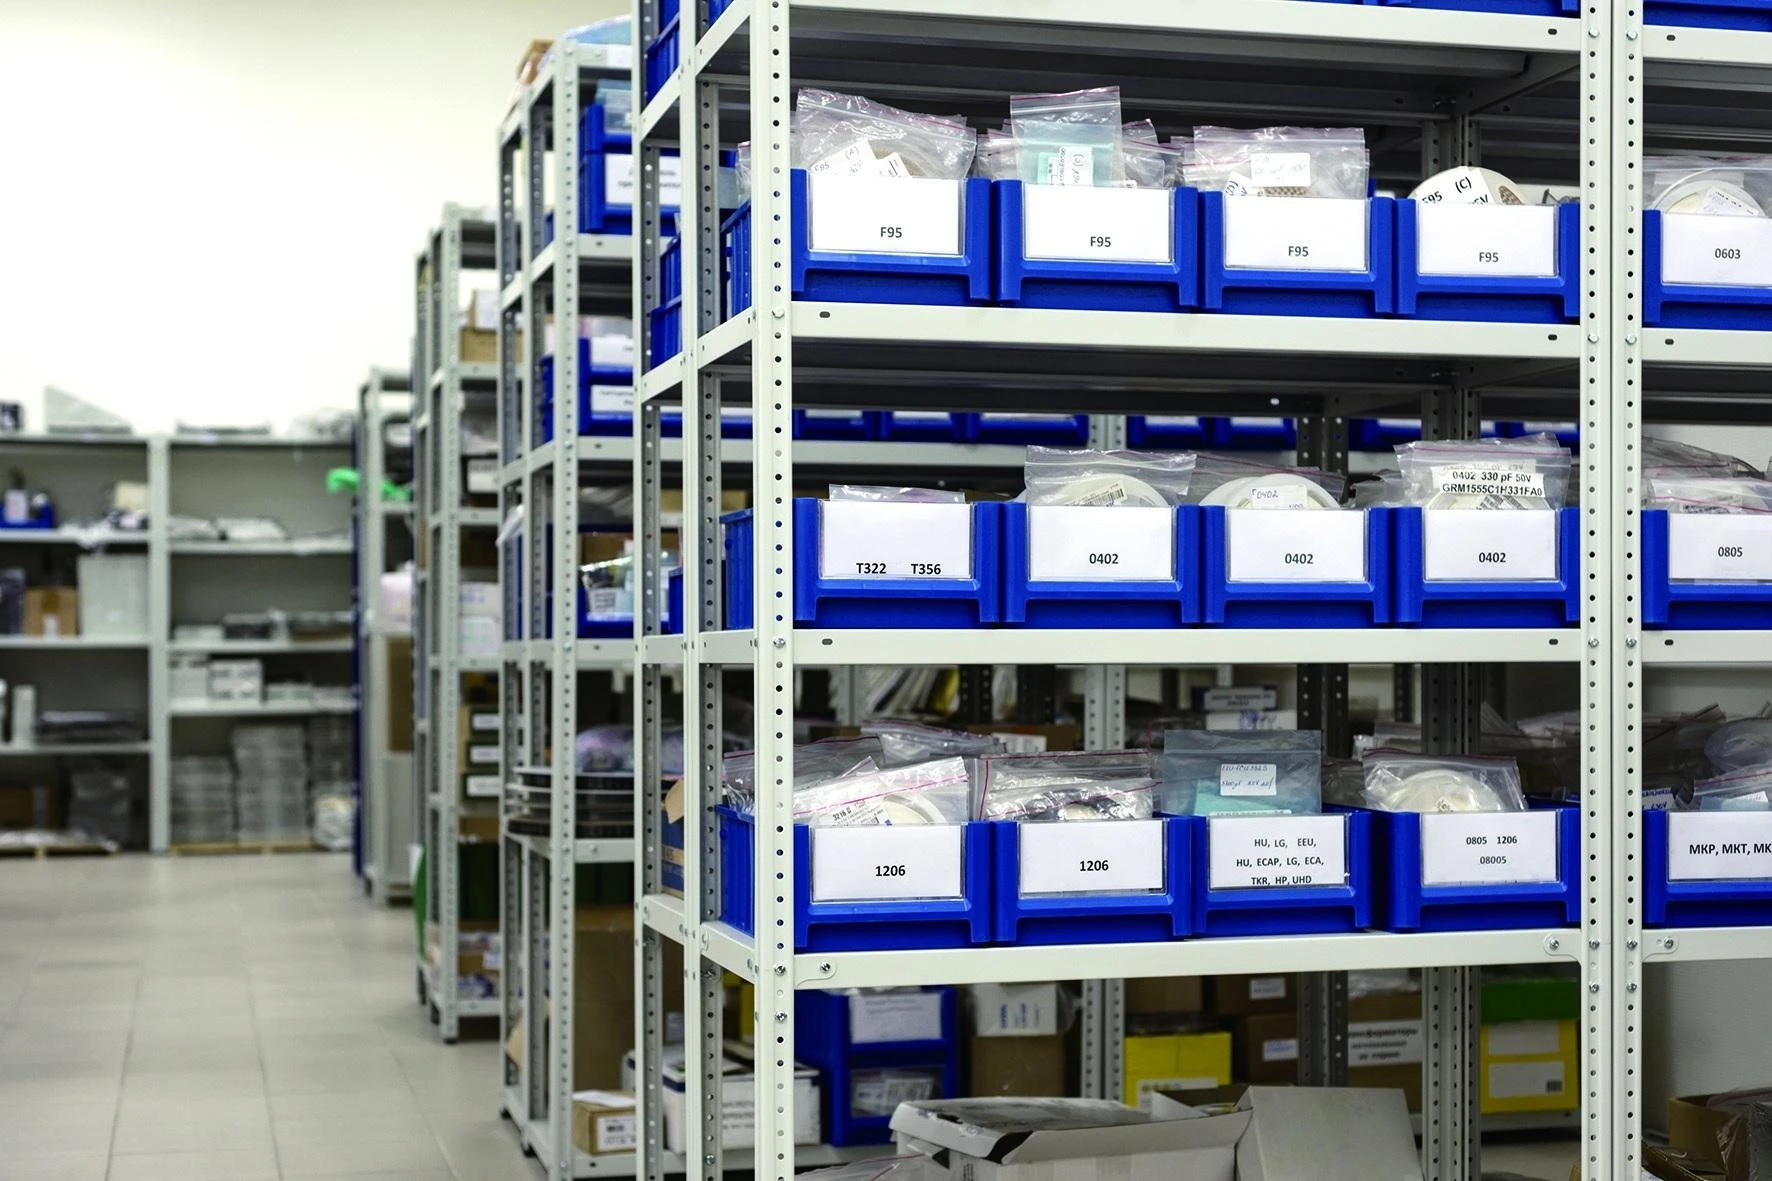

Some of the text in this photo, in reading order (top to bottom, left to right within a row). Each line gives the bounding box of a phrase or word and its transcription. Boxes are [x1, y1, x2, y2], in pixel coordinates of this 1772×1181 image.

[1454, 176, 1472, 194] (C)
[880, 226, 903, 239] F95
[1089, 236, 1112, 248] F95
[1288, 245, 1309, 258] F95
[1478, 251, 1499, 263] F95
[1714, 247, 1741, 260] 0603
[1452, 470, 1532, 483] 0402 330 pF 50V
[1088, 552, 1119, 565] 0402
[1284, 552, 1314, 565] 0402
[1478, 551, 1507, 564] 0402
[1717, 546, 1743, 558] 0805
[855, 562, 942, 575] T322 T356
[1254, 837, 1317, 849] HU, LG, EEU,
[1465, 835, 1518, 846] 0805 1206
[1689, 843, 1719, 857] MKP,
[1722, 843, 1751, 856] MKT,
[1079, 859, 1110, 872] 1206
[1236, 856, 1325, 868] HU, ECAP, LG, ECA,
[1479, 855, 1507, 865] 08005
[875, 864, 906, 877] 1206
[1250, 875, 1312, 886] TKR, HP, UHD
